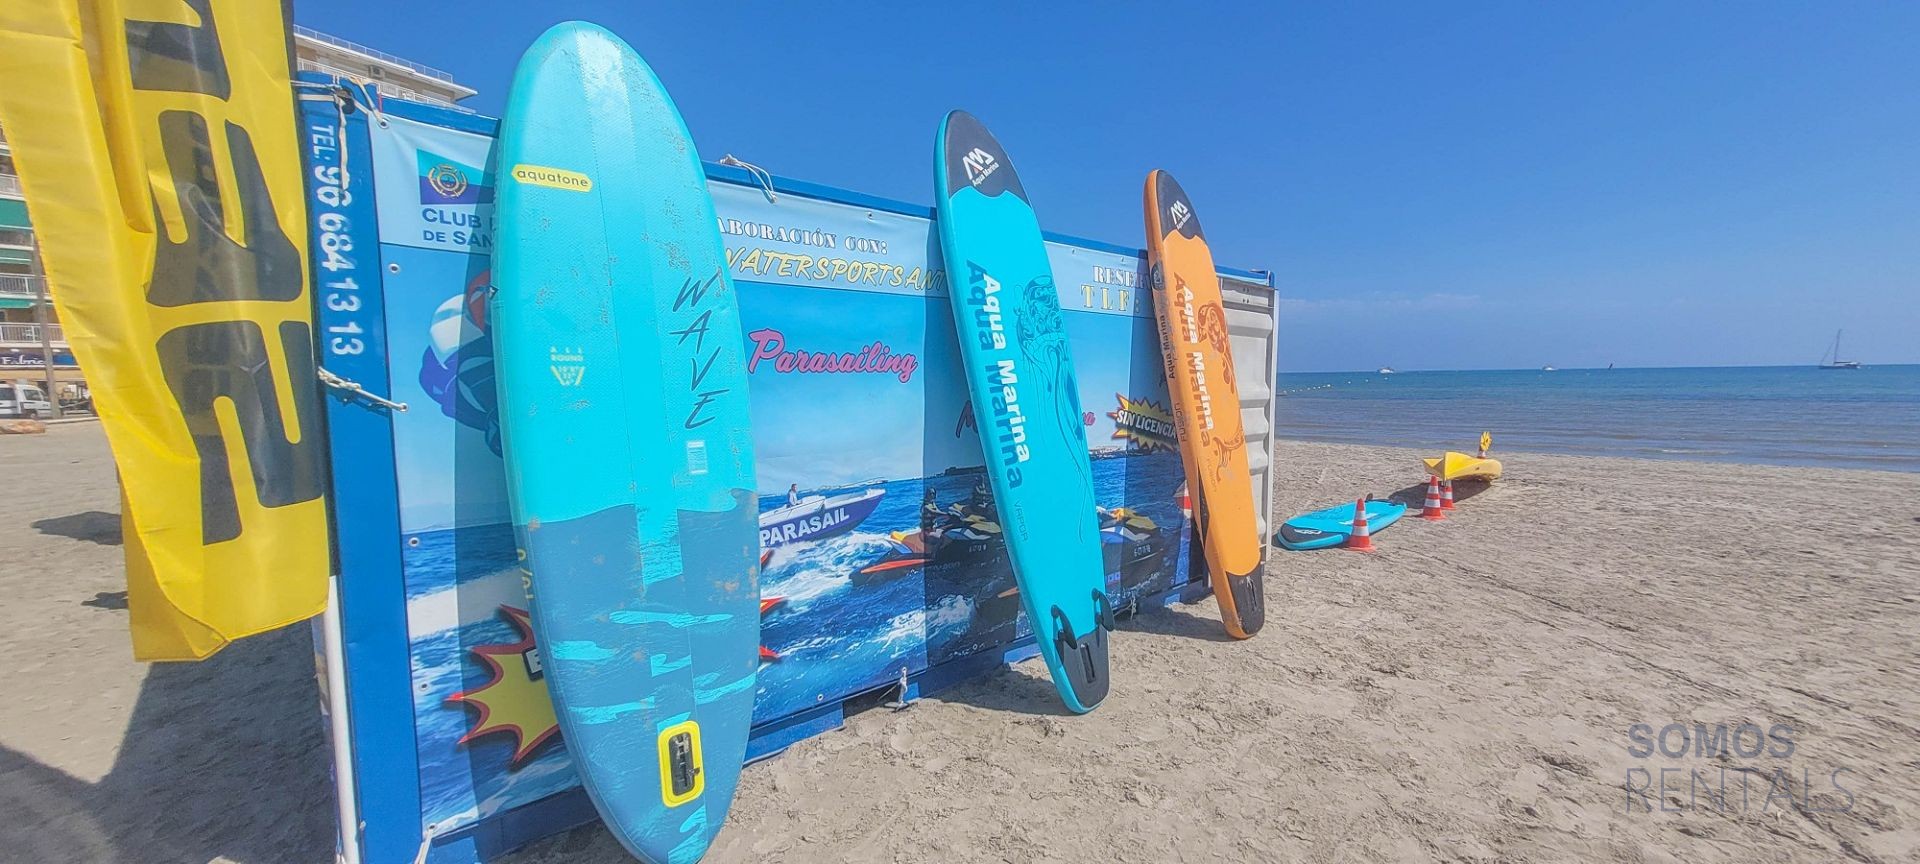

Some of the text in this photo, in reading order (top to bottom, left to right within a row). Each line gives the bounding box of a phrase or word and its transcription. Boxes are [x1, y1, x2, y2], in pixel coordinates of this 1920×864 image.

[517, 170, 588, 187] aquatone
[312, 125, 364, 355] TEL: 96 684 13 13
[422, 208, 482, 228] CLUB
[423, 230, 446, 242] DE
[845, 236, 888, 254] CON:
[669, 266, 729, 429] WAVE
[748, 328, 918, 383] Parasailing
[983, 273, 1030, 462] Aqua Marina
[1160, 315, 1175, 379] Aqua Marina
[1183, 285, 1214, 430] Aqua Marina
[966, 259, 1022, 489] Aqua Marina
[1116, 410, 1135, 426] SIN
[1136, 415, 1176, 439] LICENCIA
[760, 508, 850, 547] PARASAIL
[1014, 501, 1029, 542] VAPOR
